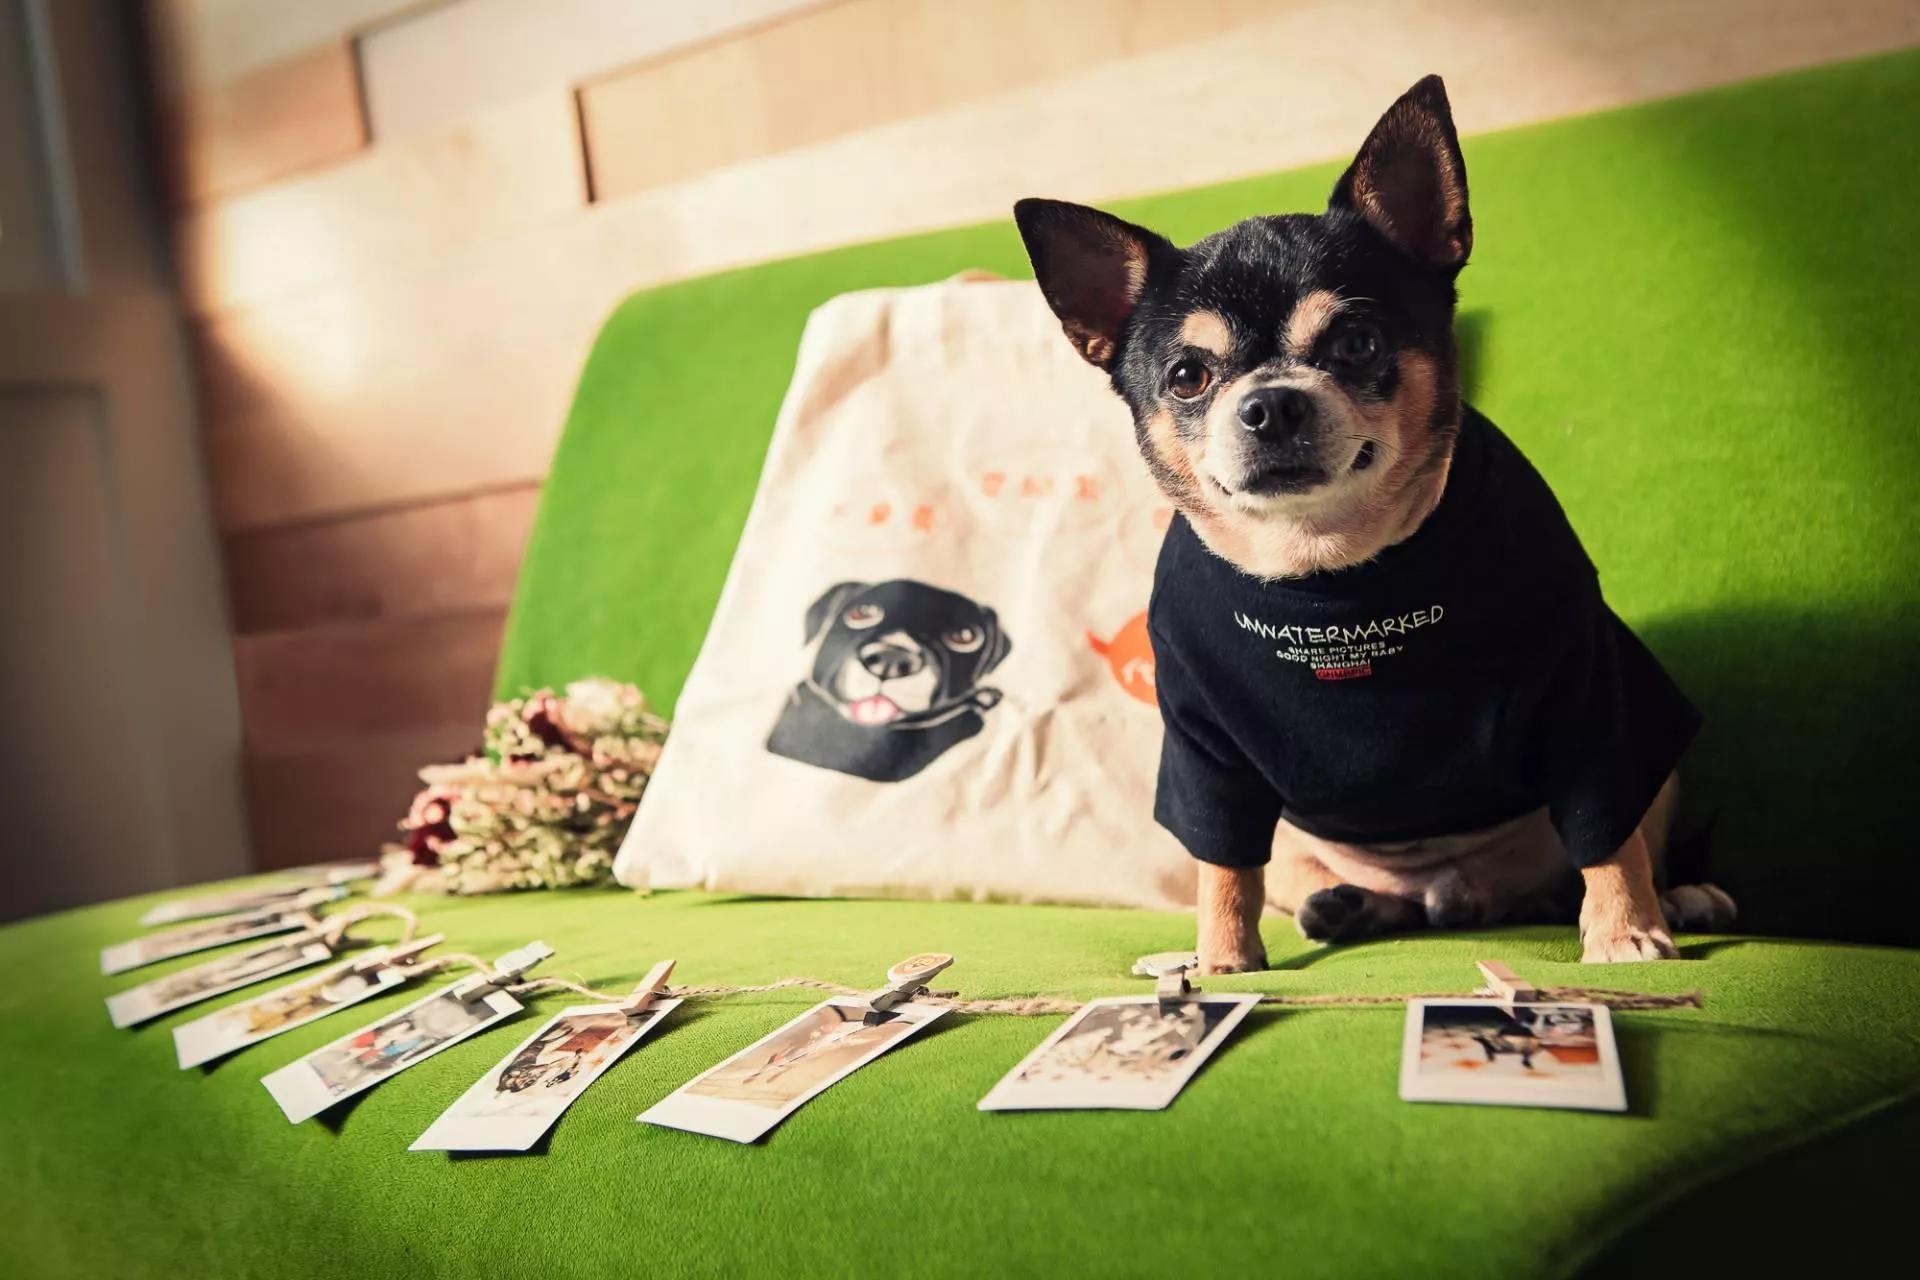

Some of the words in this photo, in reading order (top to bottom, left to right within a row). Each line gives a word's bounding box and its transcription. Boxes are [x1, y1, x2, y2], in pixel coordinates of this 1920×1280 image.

[1288, 646, 1325, 655] SHARE
[1328, 642, 1387, 653] PICTURES
[1276, 650, 1308, 663] GOOD
[1311, 653, 1346, 662] NIGHT
[1310, 659, 1372, 670] SHANGHAI
